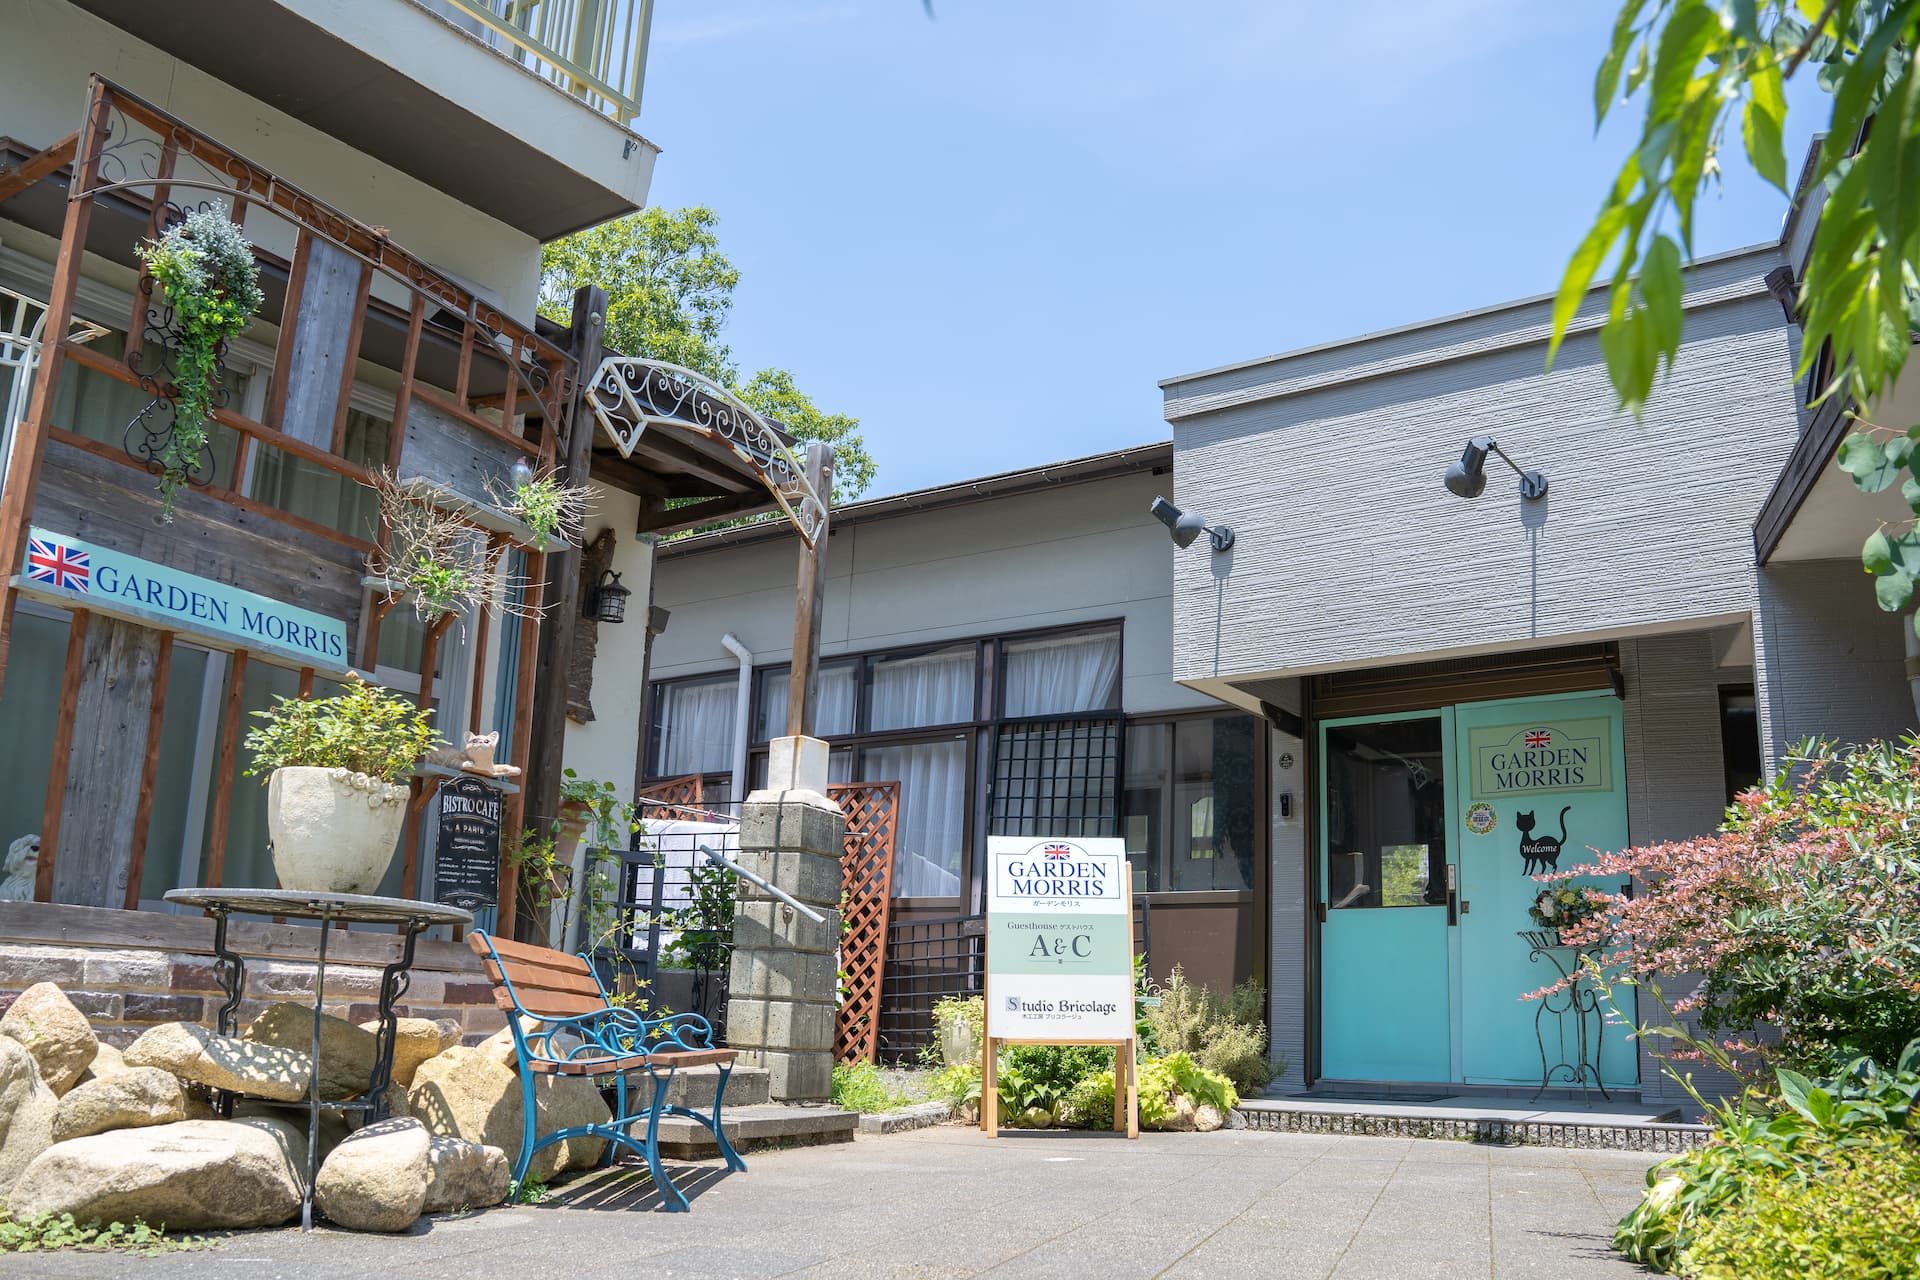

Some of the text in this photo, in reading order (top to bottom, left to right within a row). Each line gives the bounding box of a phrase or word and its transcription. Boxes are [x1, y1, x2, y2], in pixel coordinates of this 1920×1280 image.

[96, 565, 343, 657] GARDEN MORRIS
[1491, 747, 1589, 771] GARDEN
[1496, 766, 1585, 790] MORRIS
[442, 795, 475, 814] BISTRO
[463, 824, 484, 835] PARIS
[1521, 842, 1558, 854] Welcome
[1008, 861, 1107, 878] GARDEN
[1012, 879, 1104, 896] MORRIS
[1007, 921, 1057, 930] Guesthouse
[1029, 934, 1092, 958] A & C
[1007, 997, 1117, 1016] Studio Bricolage
